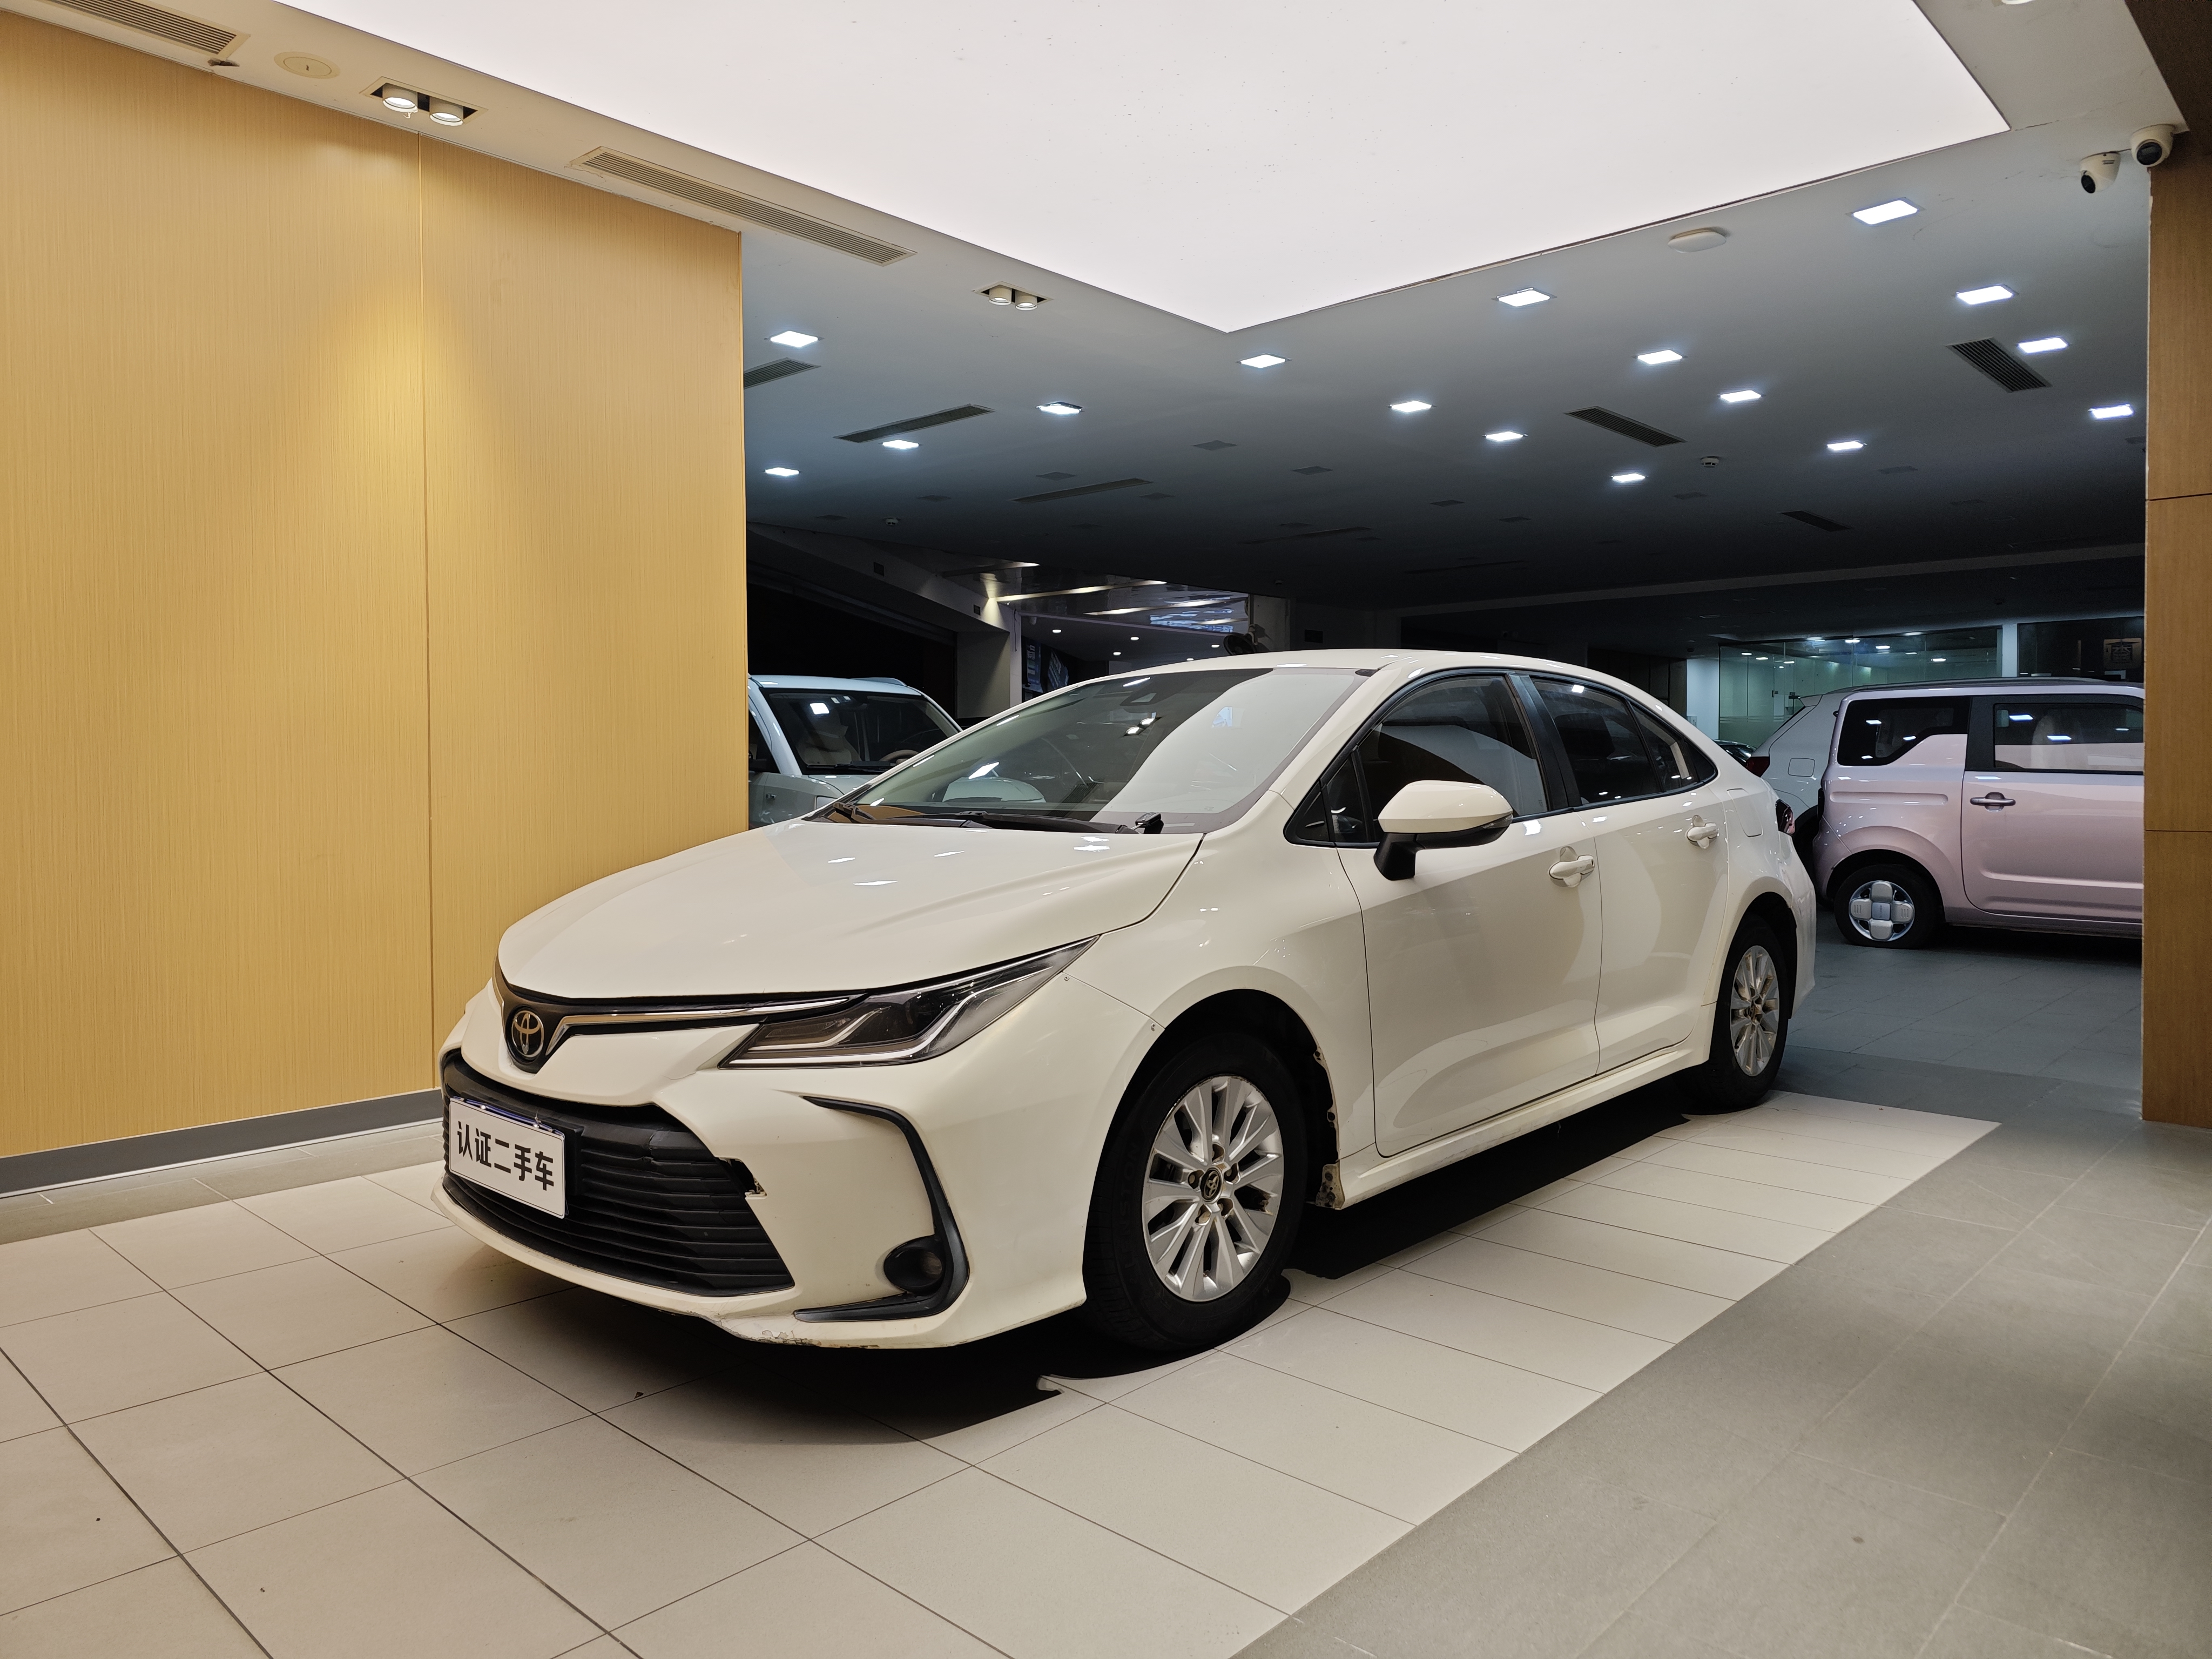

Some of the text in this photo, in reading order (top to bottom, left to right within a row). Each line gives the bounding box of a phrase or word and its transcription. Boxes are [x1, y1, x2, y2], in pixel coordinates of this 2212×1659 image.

[457, 1121, 554, 1191] 认证二手车
